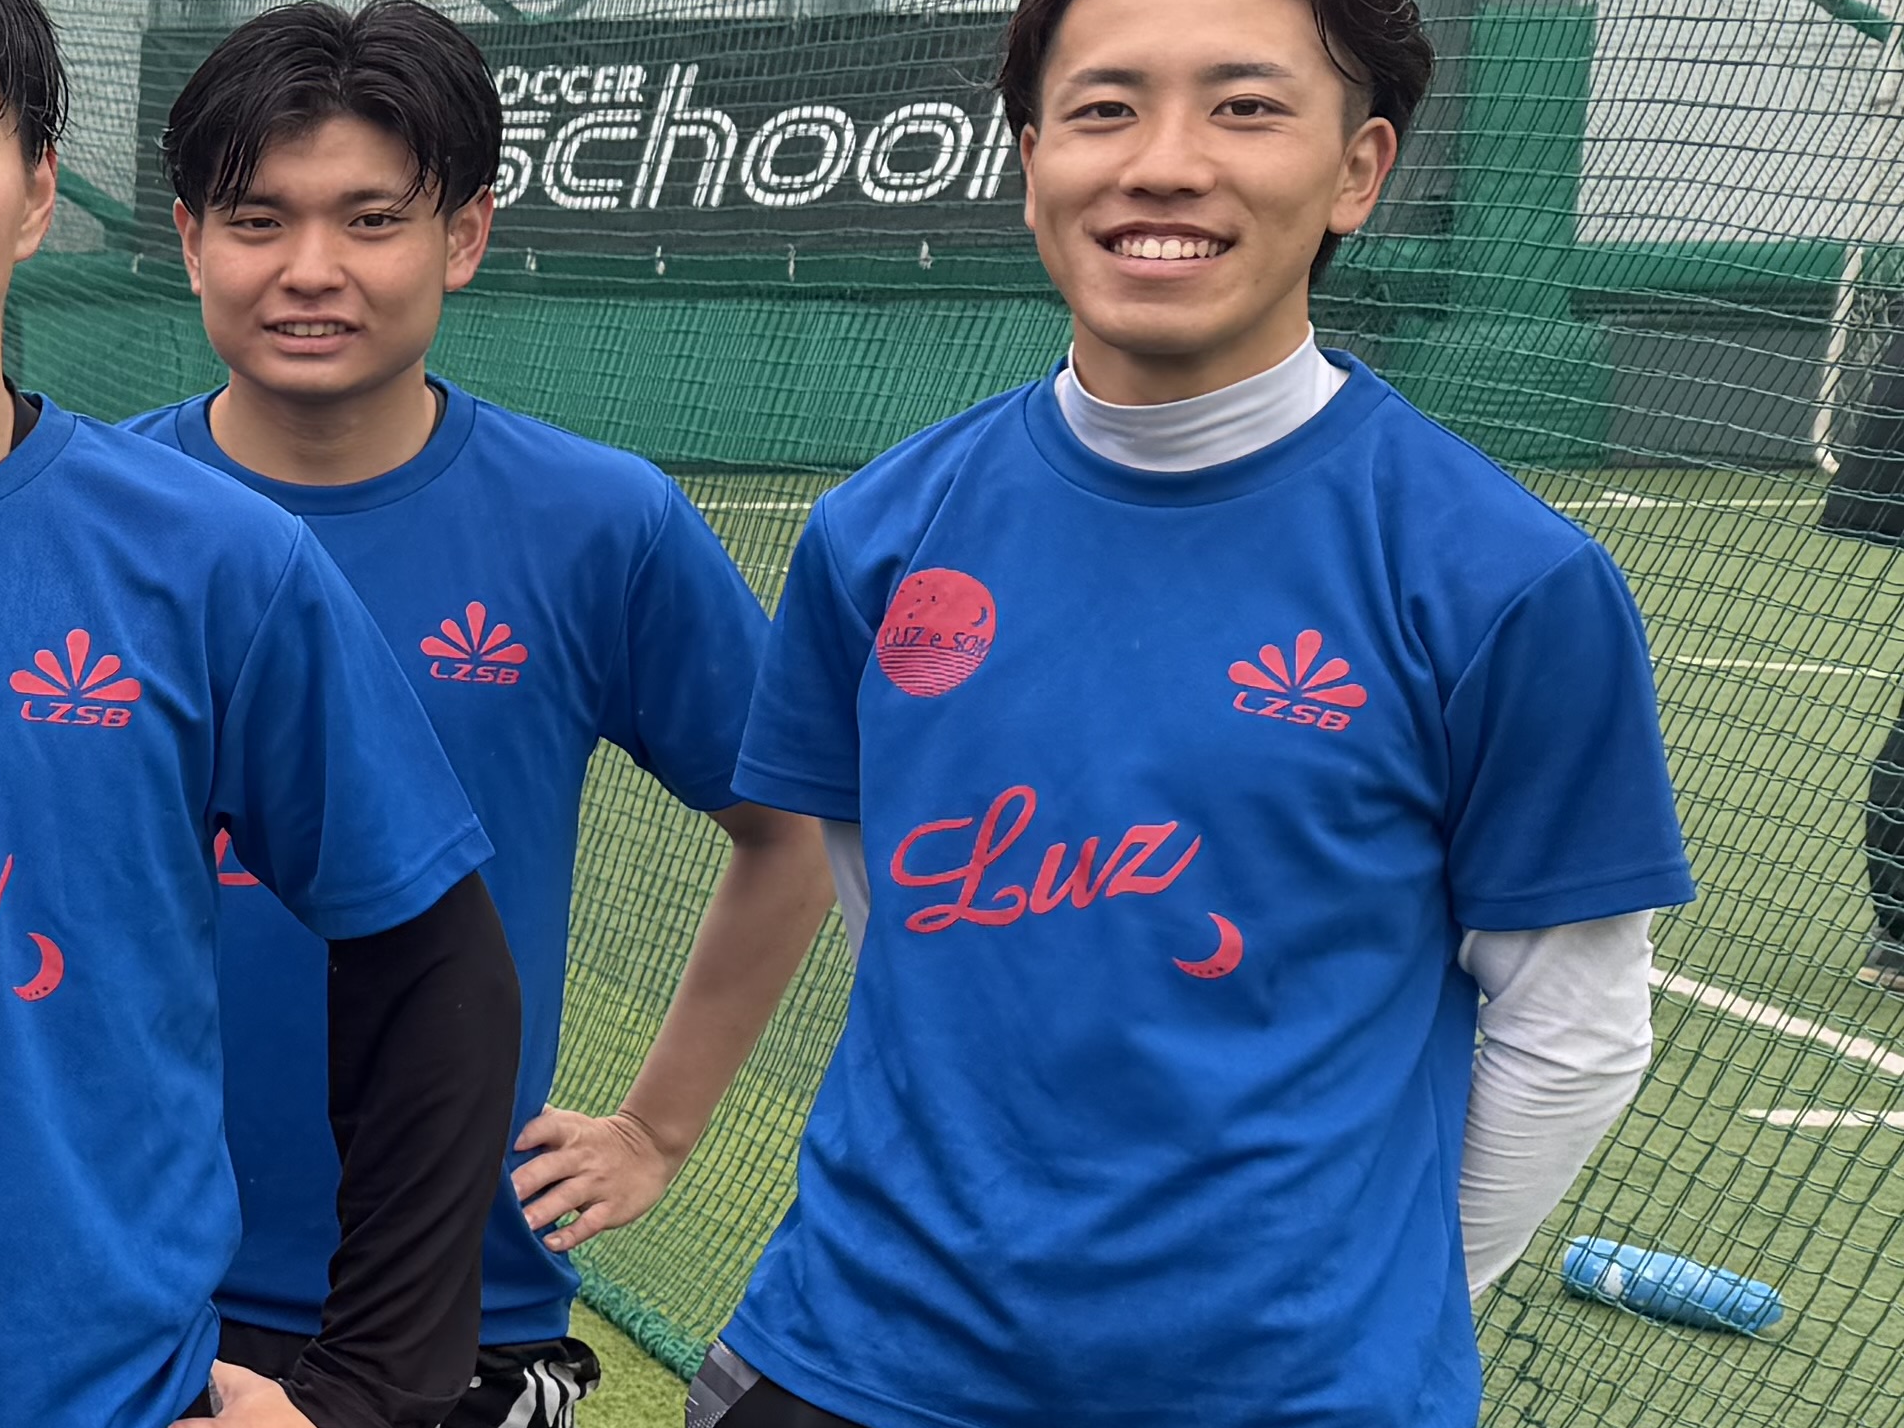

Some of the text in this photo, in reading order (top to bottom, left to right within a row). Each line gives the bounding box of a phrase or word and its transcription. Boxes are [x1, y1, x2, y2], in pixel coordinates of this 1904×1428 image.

[495, 64, 647, 105] OCCER
[885, 627, 925, 648] LUZ
[930, 633, 943, 648] e
[429, 660, 521, 686] LZSB
[19, 700, 133, 728] LZSB
[1232, 690, 1353, 732] LZSB
[890, 785, 1202, 934] Luz
